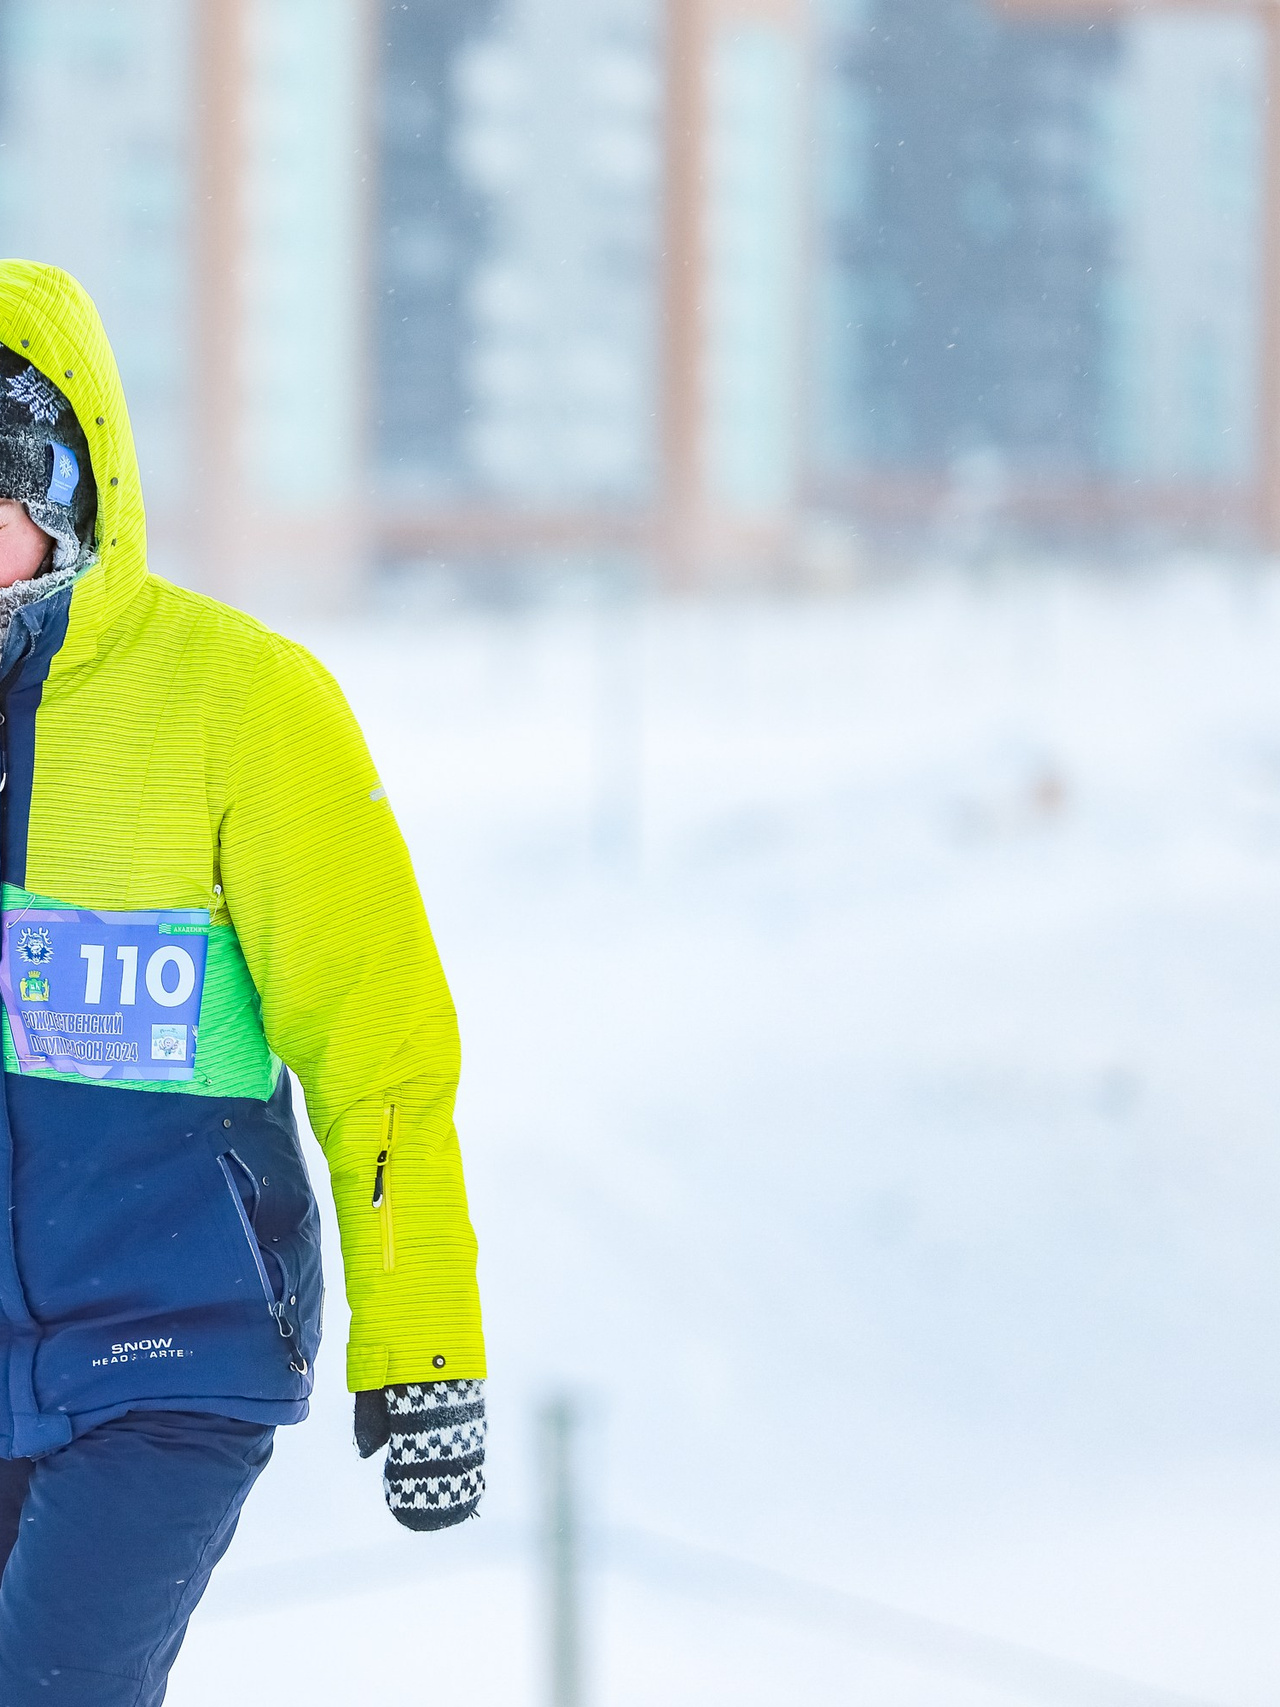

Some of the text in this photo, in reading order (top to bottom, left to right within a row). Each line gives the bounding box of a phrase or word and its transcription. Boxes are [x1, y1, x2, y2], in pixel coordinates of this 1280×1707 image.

[80, 944, 195, 1007] 110
[105, 1041, 139, 1062] 2024
[111, 1338, 173, 1354] SNOW
[92, 1350, 194, 1367] HEADARTE
